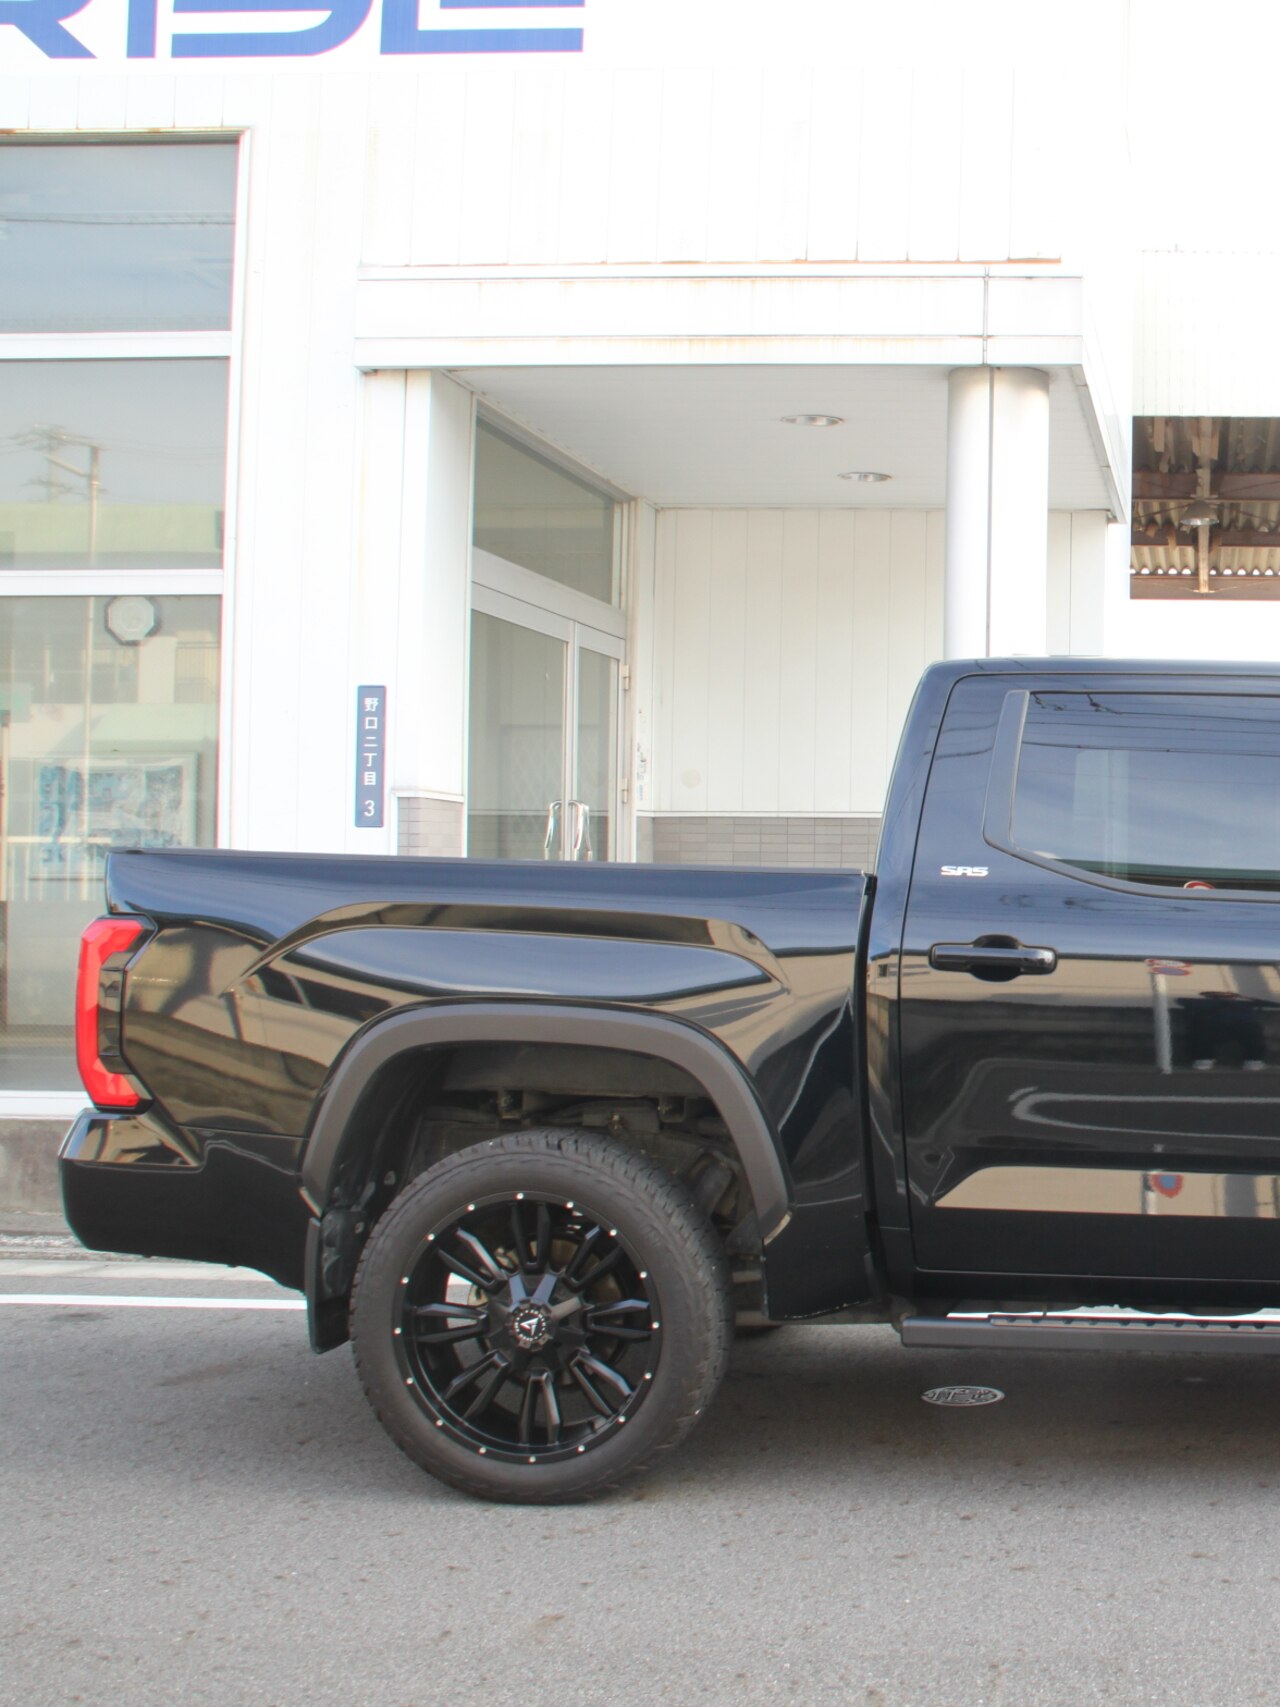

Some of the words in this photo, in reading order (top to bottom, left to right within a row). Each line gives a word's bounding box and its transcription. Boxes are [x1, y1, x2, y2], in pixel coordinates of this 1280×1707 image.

[363, 697, 379, 786] 野口二丁目
[363, 799, 376, 817] 3
[940, 865, 989, 877] SR5
